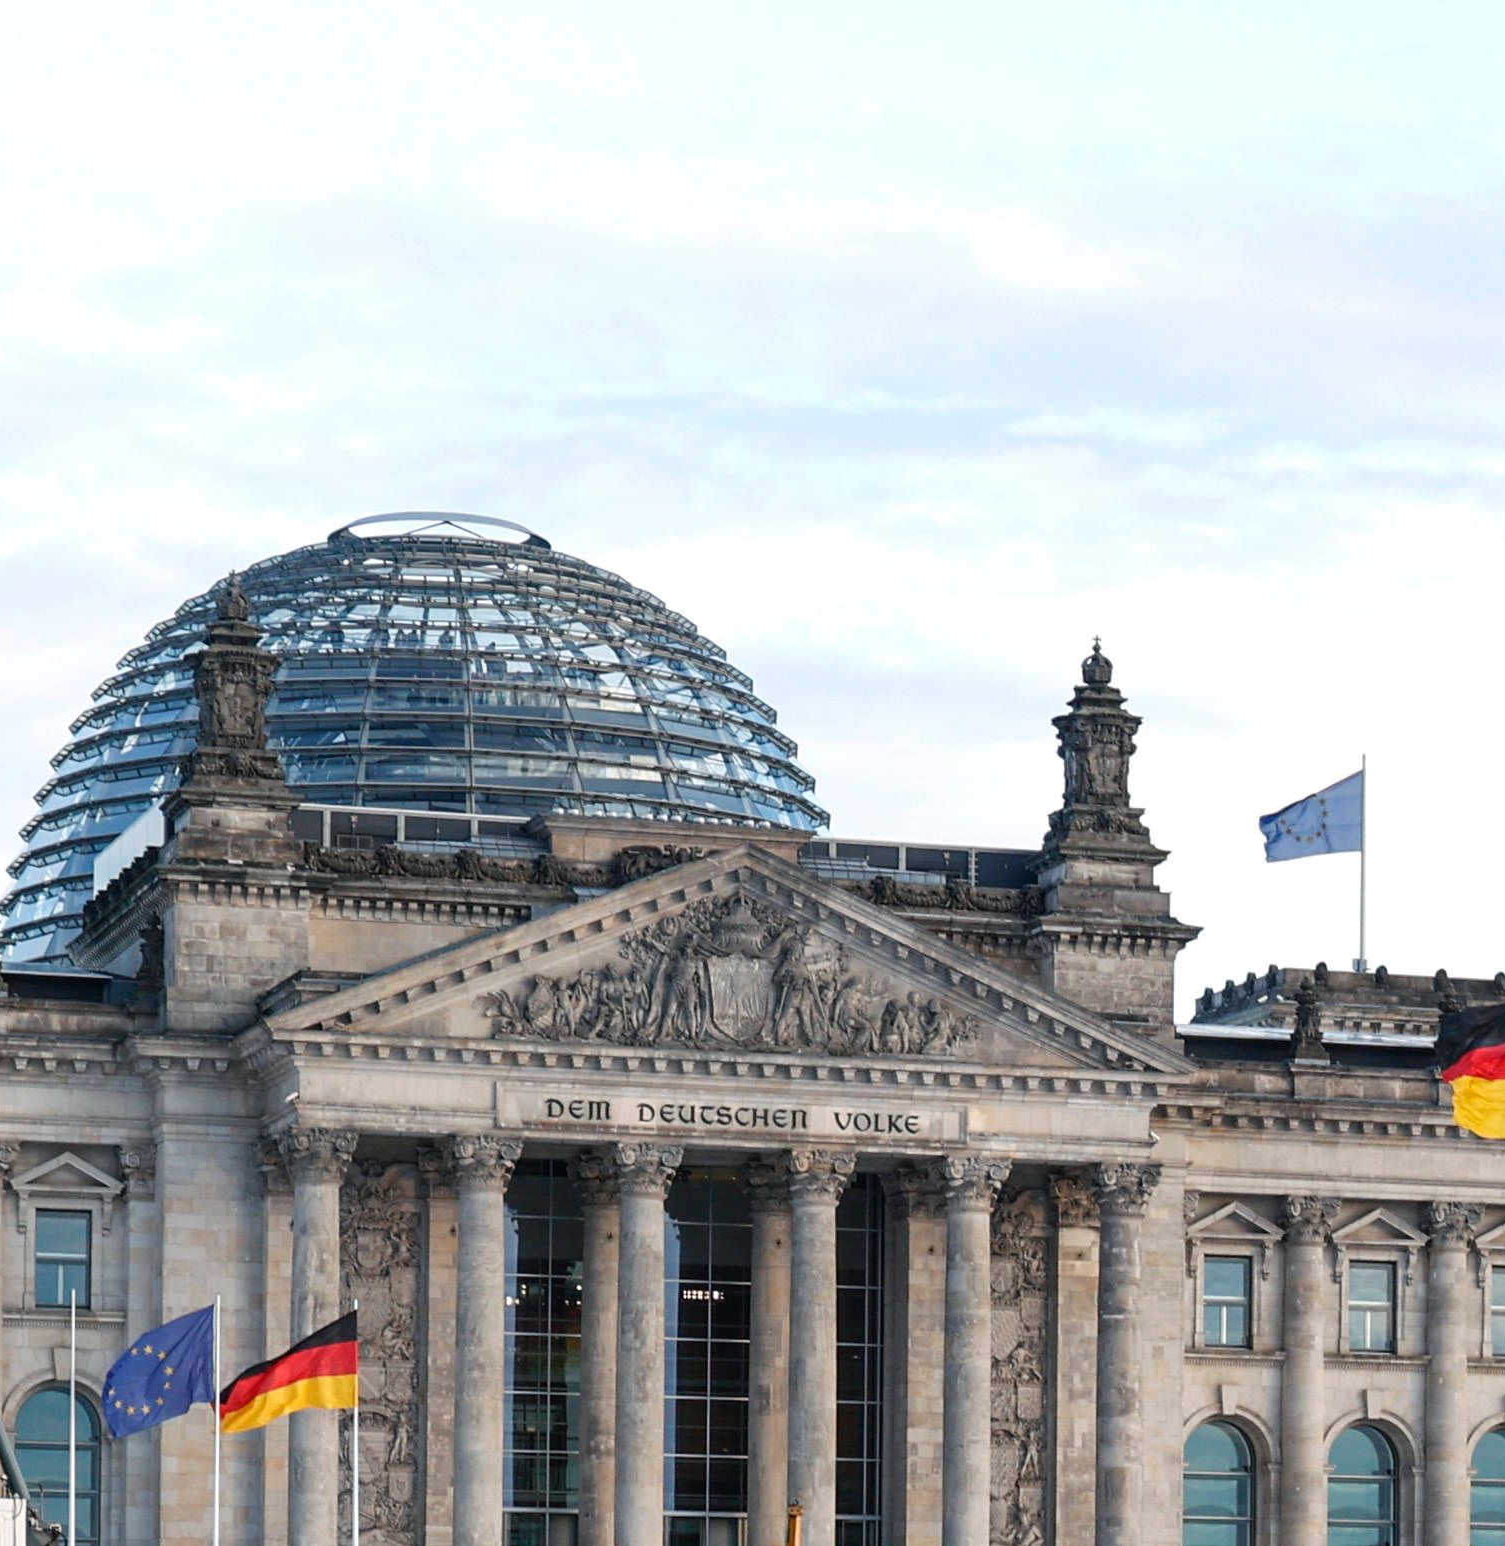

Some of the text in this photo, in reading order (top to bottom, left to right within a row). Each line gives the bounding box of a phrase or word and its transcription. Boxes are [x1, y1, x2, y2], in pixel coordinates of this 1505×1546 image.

[544, 1098, 921, 1134] DEM DEUTSCHEN VOLKE
